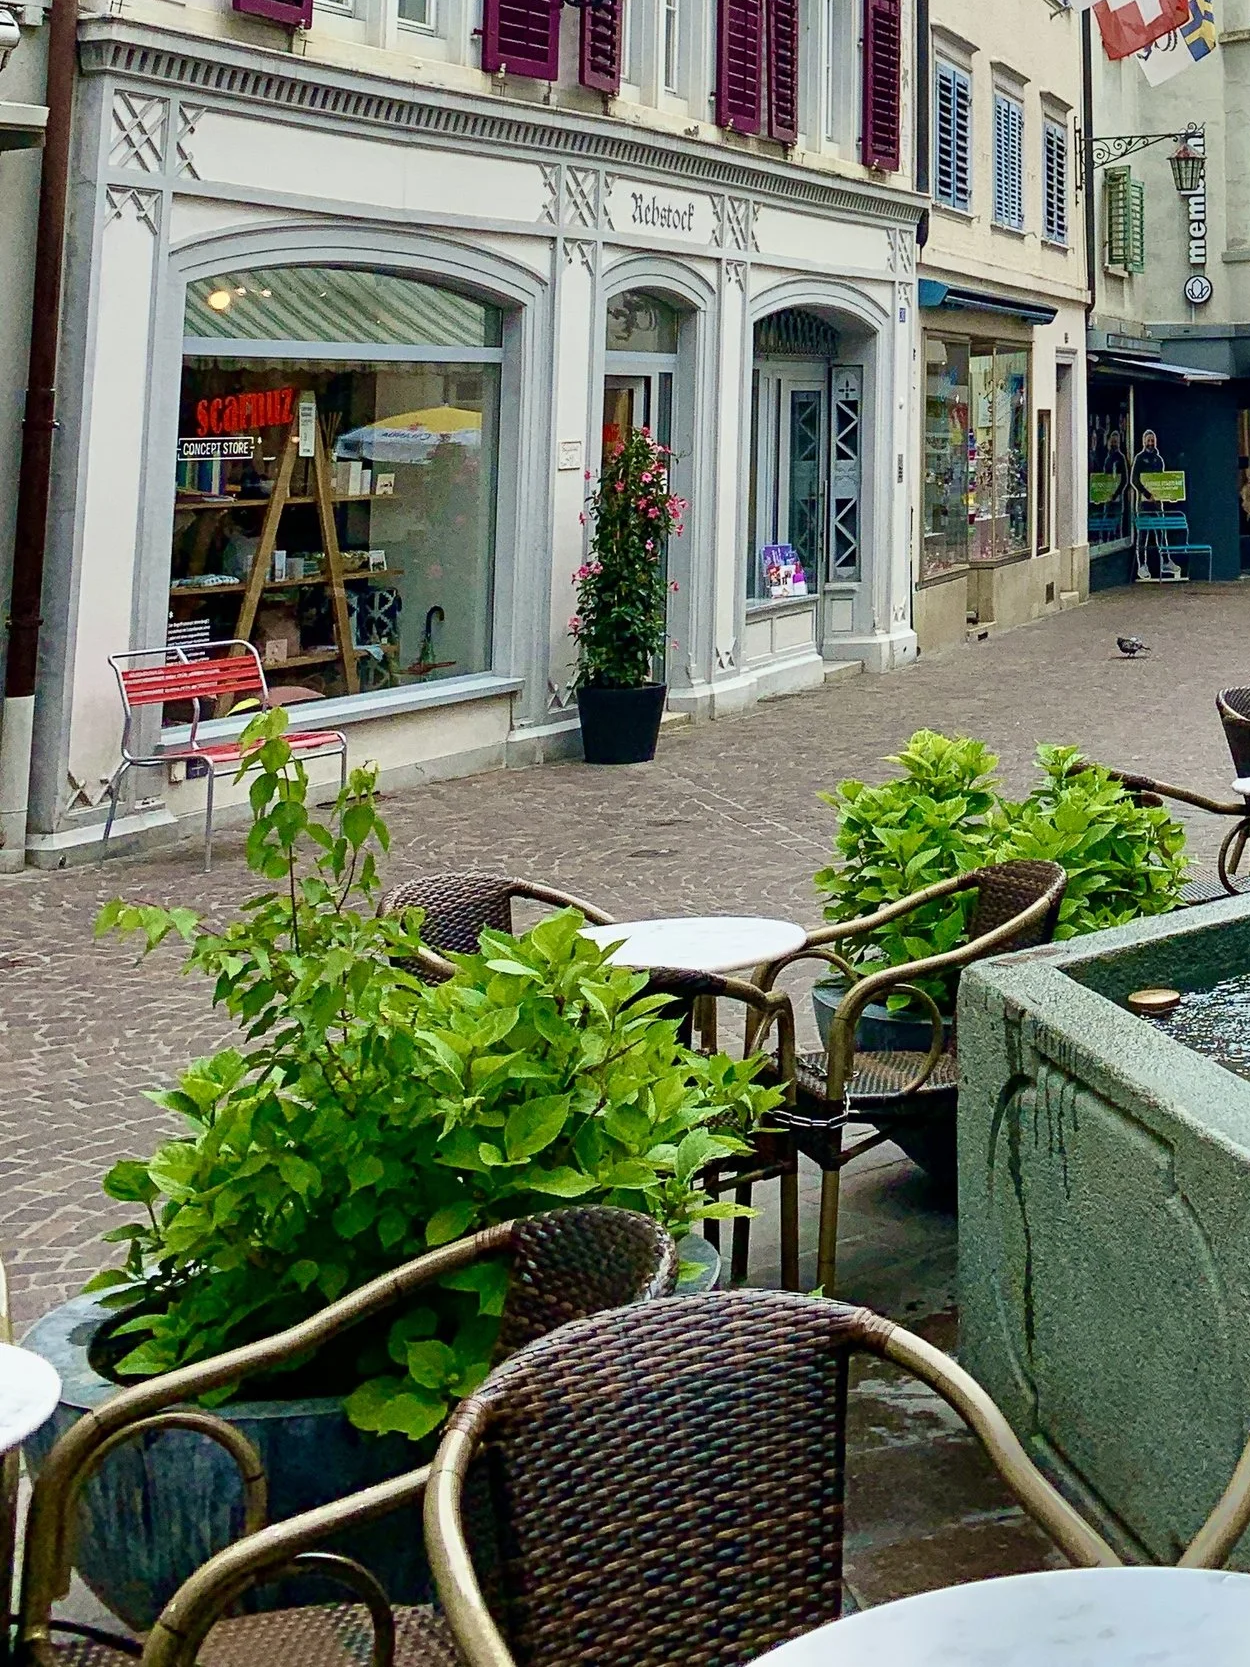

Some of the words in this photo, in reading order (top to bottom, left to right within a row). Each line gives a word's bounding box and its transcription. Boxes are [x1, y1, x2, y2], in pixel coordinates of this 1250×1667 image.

[631, 192, 694, 232] Rebstock
[183, 442, 221, 456] CONCEPT
[222, 441, 249, 455] STORE
